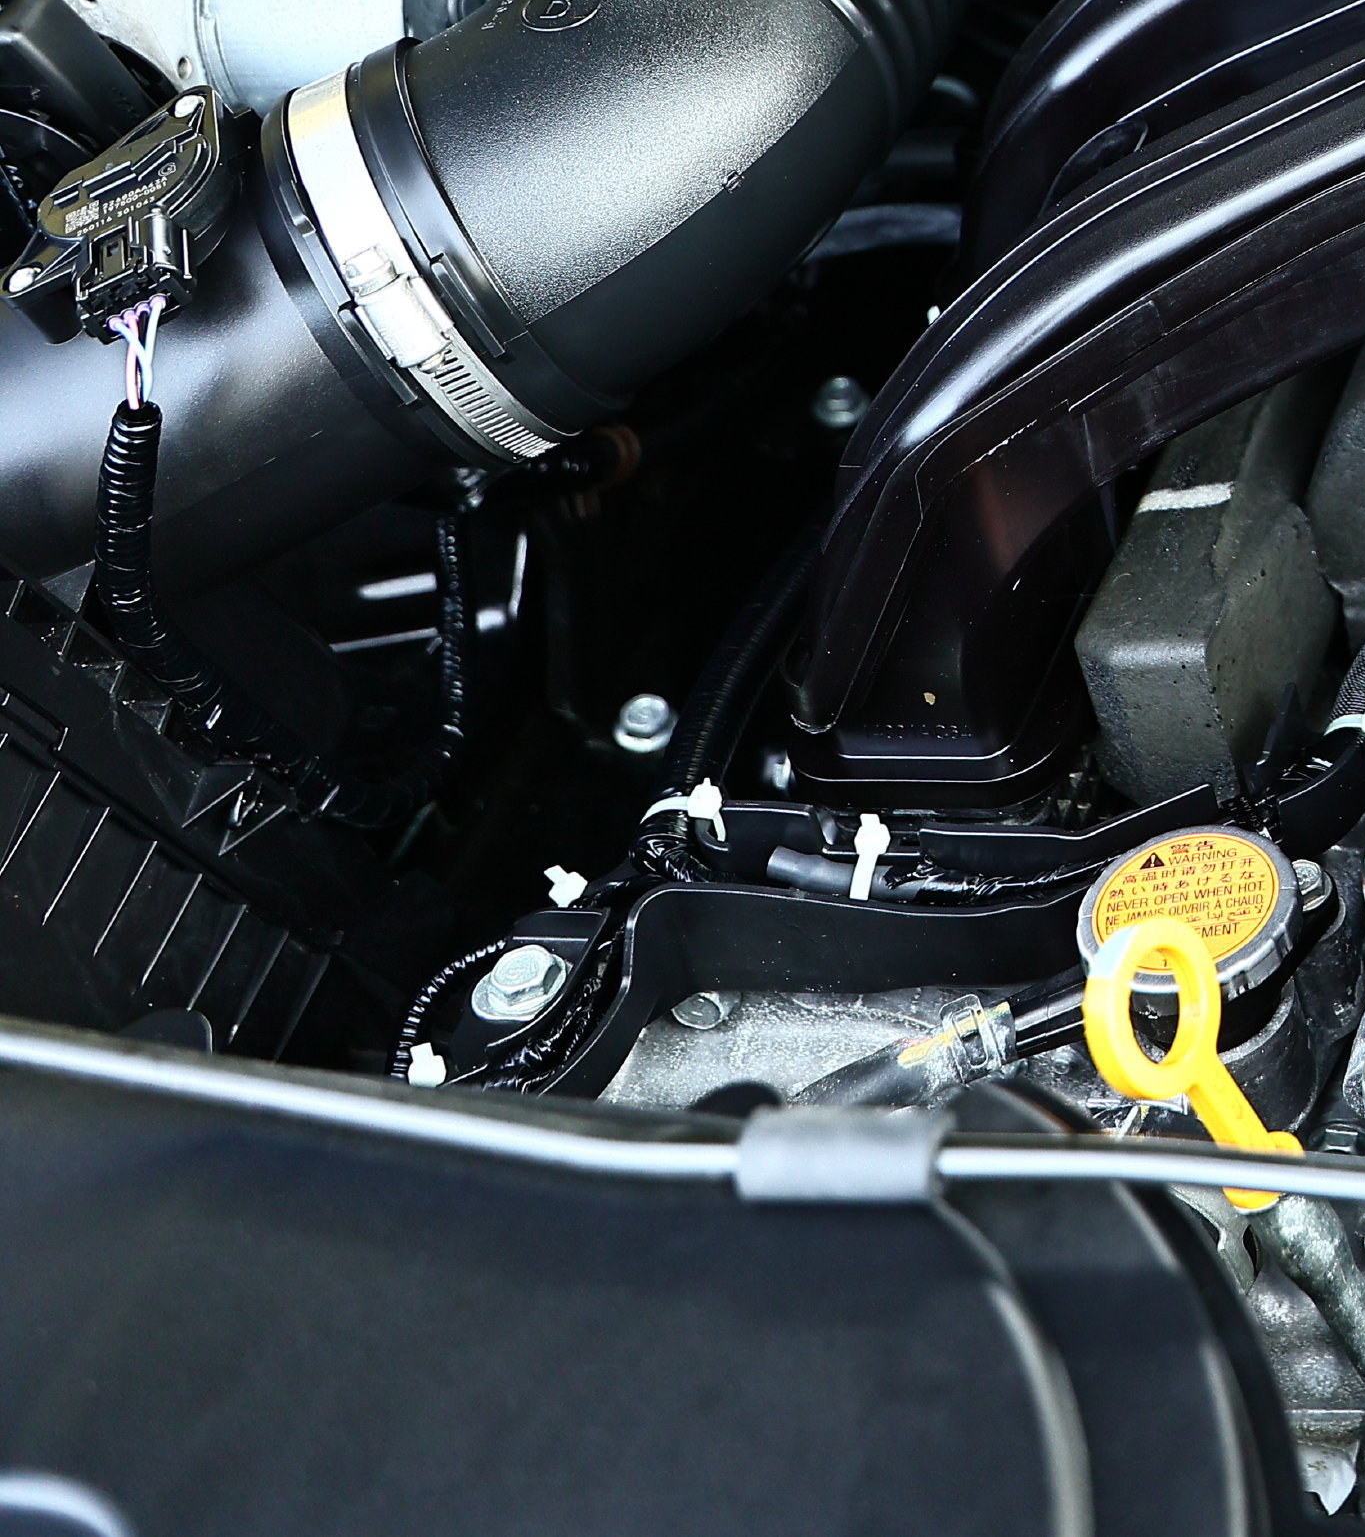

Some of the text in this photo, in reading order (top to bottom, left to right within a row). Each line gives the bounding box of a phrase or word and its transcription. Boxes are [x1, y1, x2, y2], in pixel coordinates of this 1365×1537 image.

[1168, 848, 1238, 865] WARNING
[1106, 897, 1149, 913] NEVER
[1153, 890, 1190, 906] OPEN
[1193, 885, 1233, 901] WHEN
[1105, 915, 1121, 927] NE
[1167, 901, 1210, 917] OUVRIR
